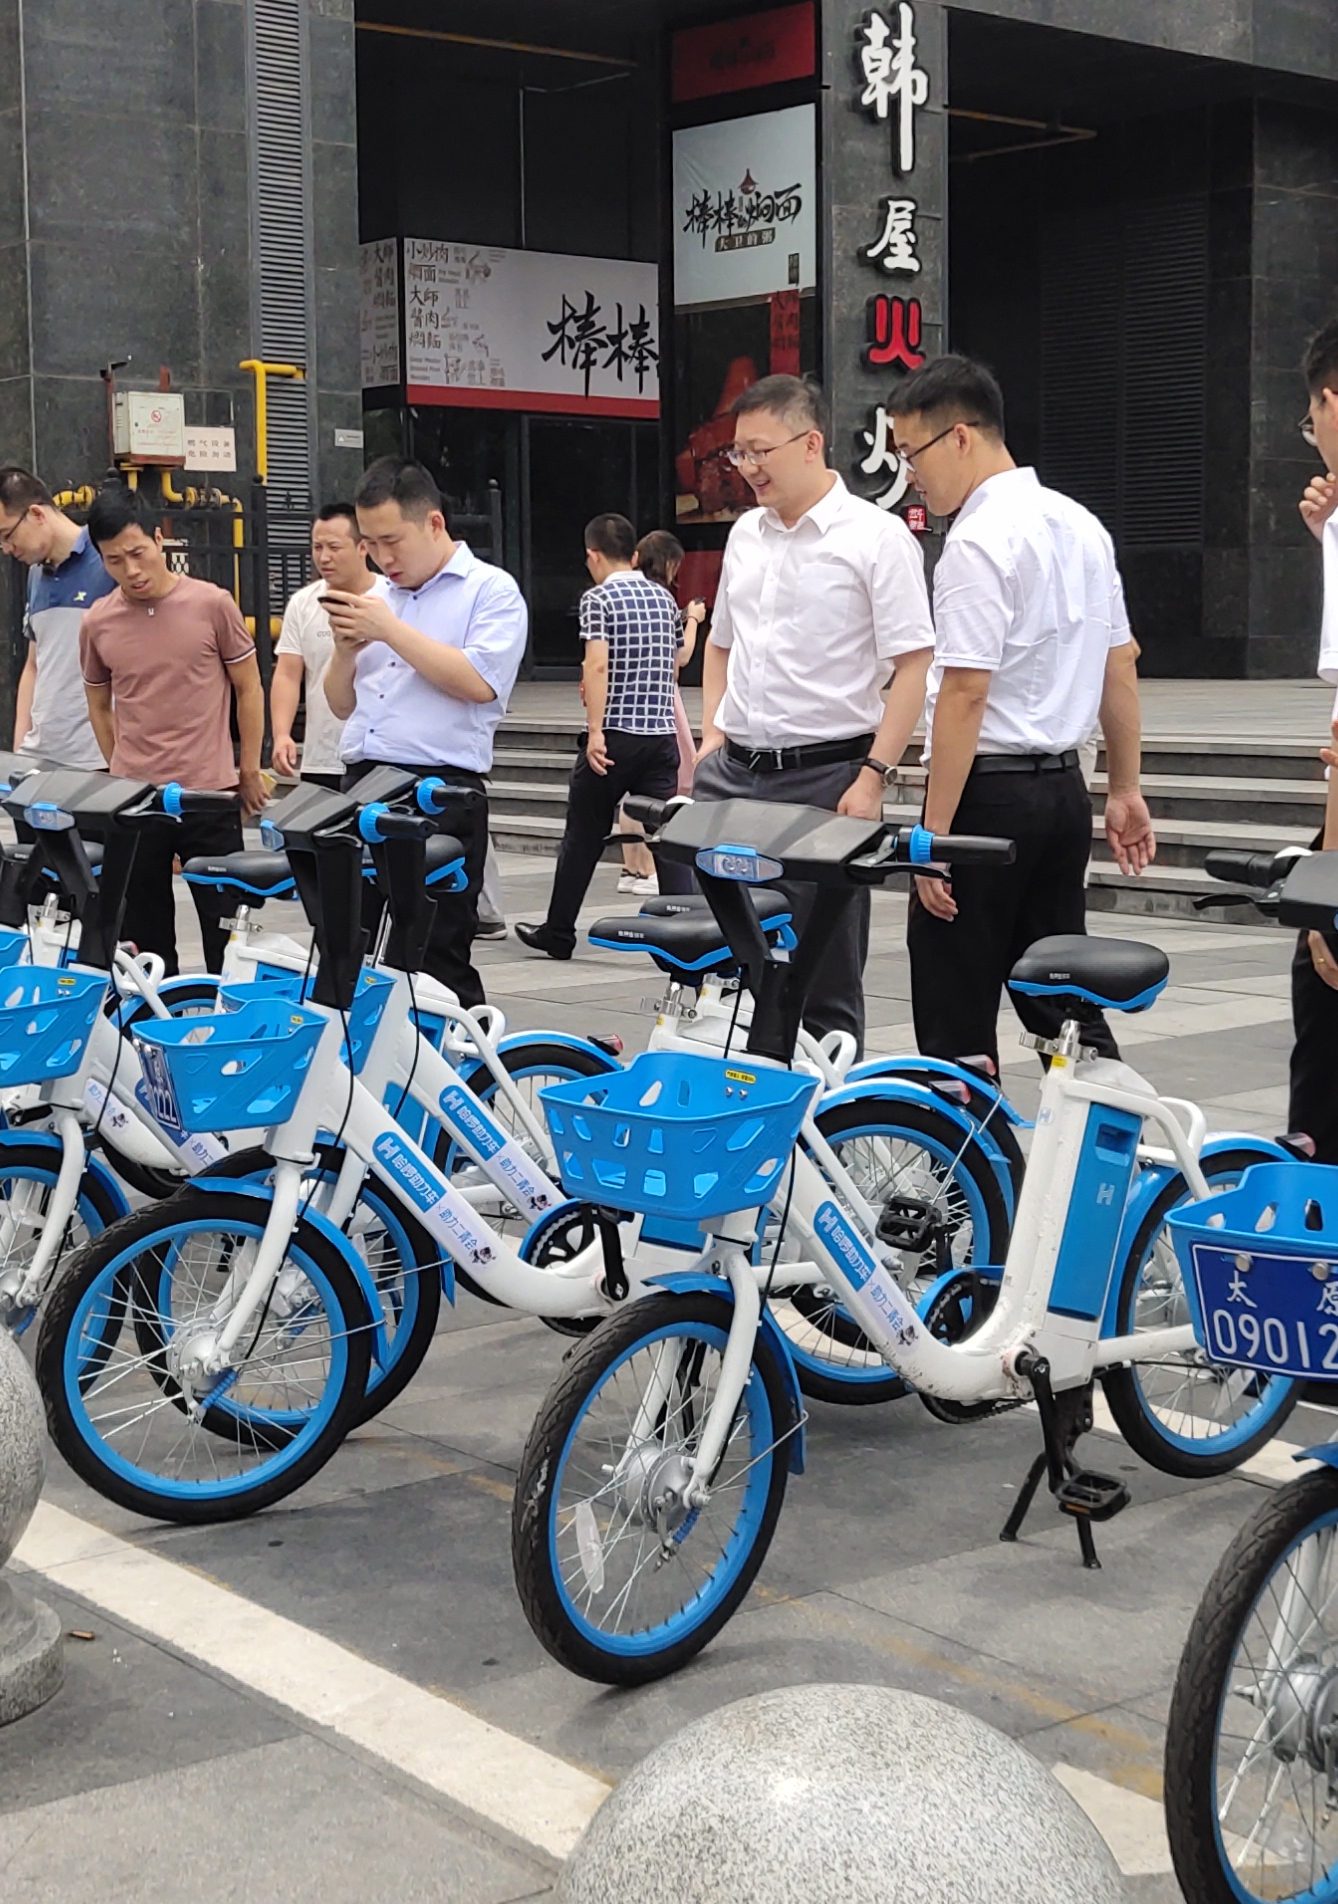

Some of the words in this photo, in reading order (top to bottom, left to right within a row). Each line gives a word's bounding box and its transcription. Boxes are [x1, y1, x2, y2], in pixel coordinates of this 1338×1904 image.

[391, 1153, 441, 1206] 哈啰助力车
[437, 1207, 479, 1251] 助力二青会
[498, 1157, 536, 1198] 助力二青会
[869, 1284, 905, 1333] 助力二青会
